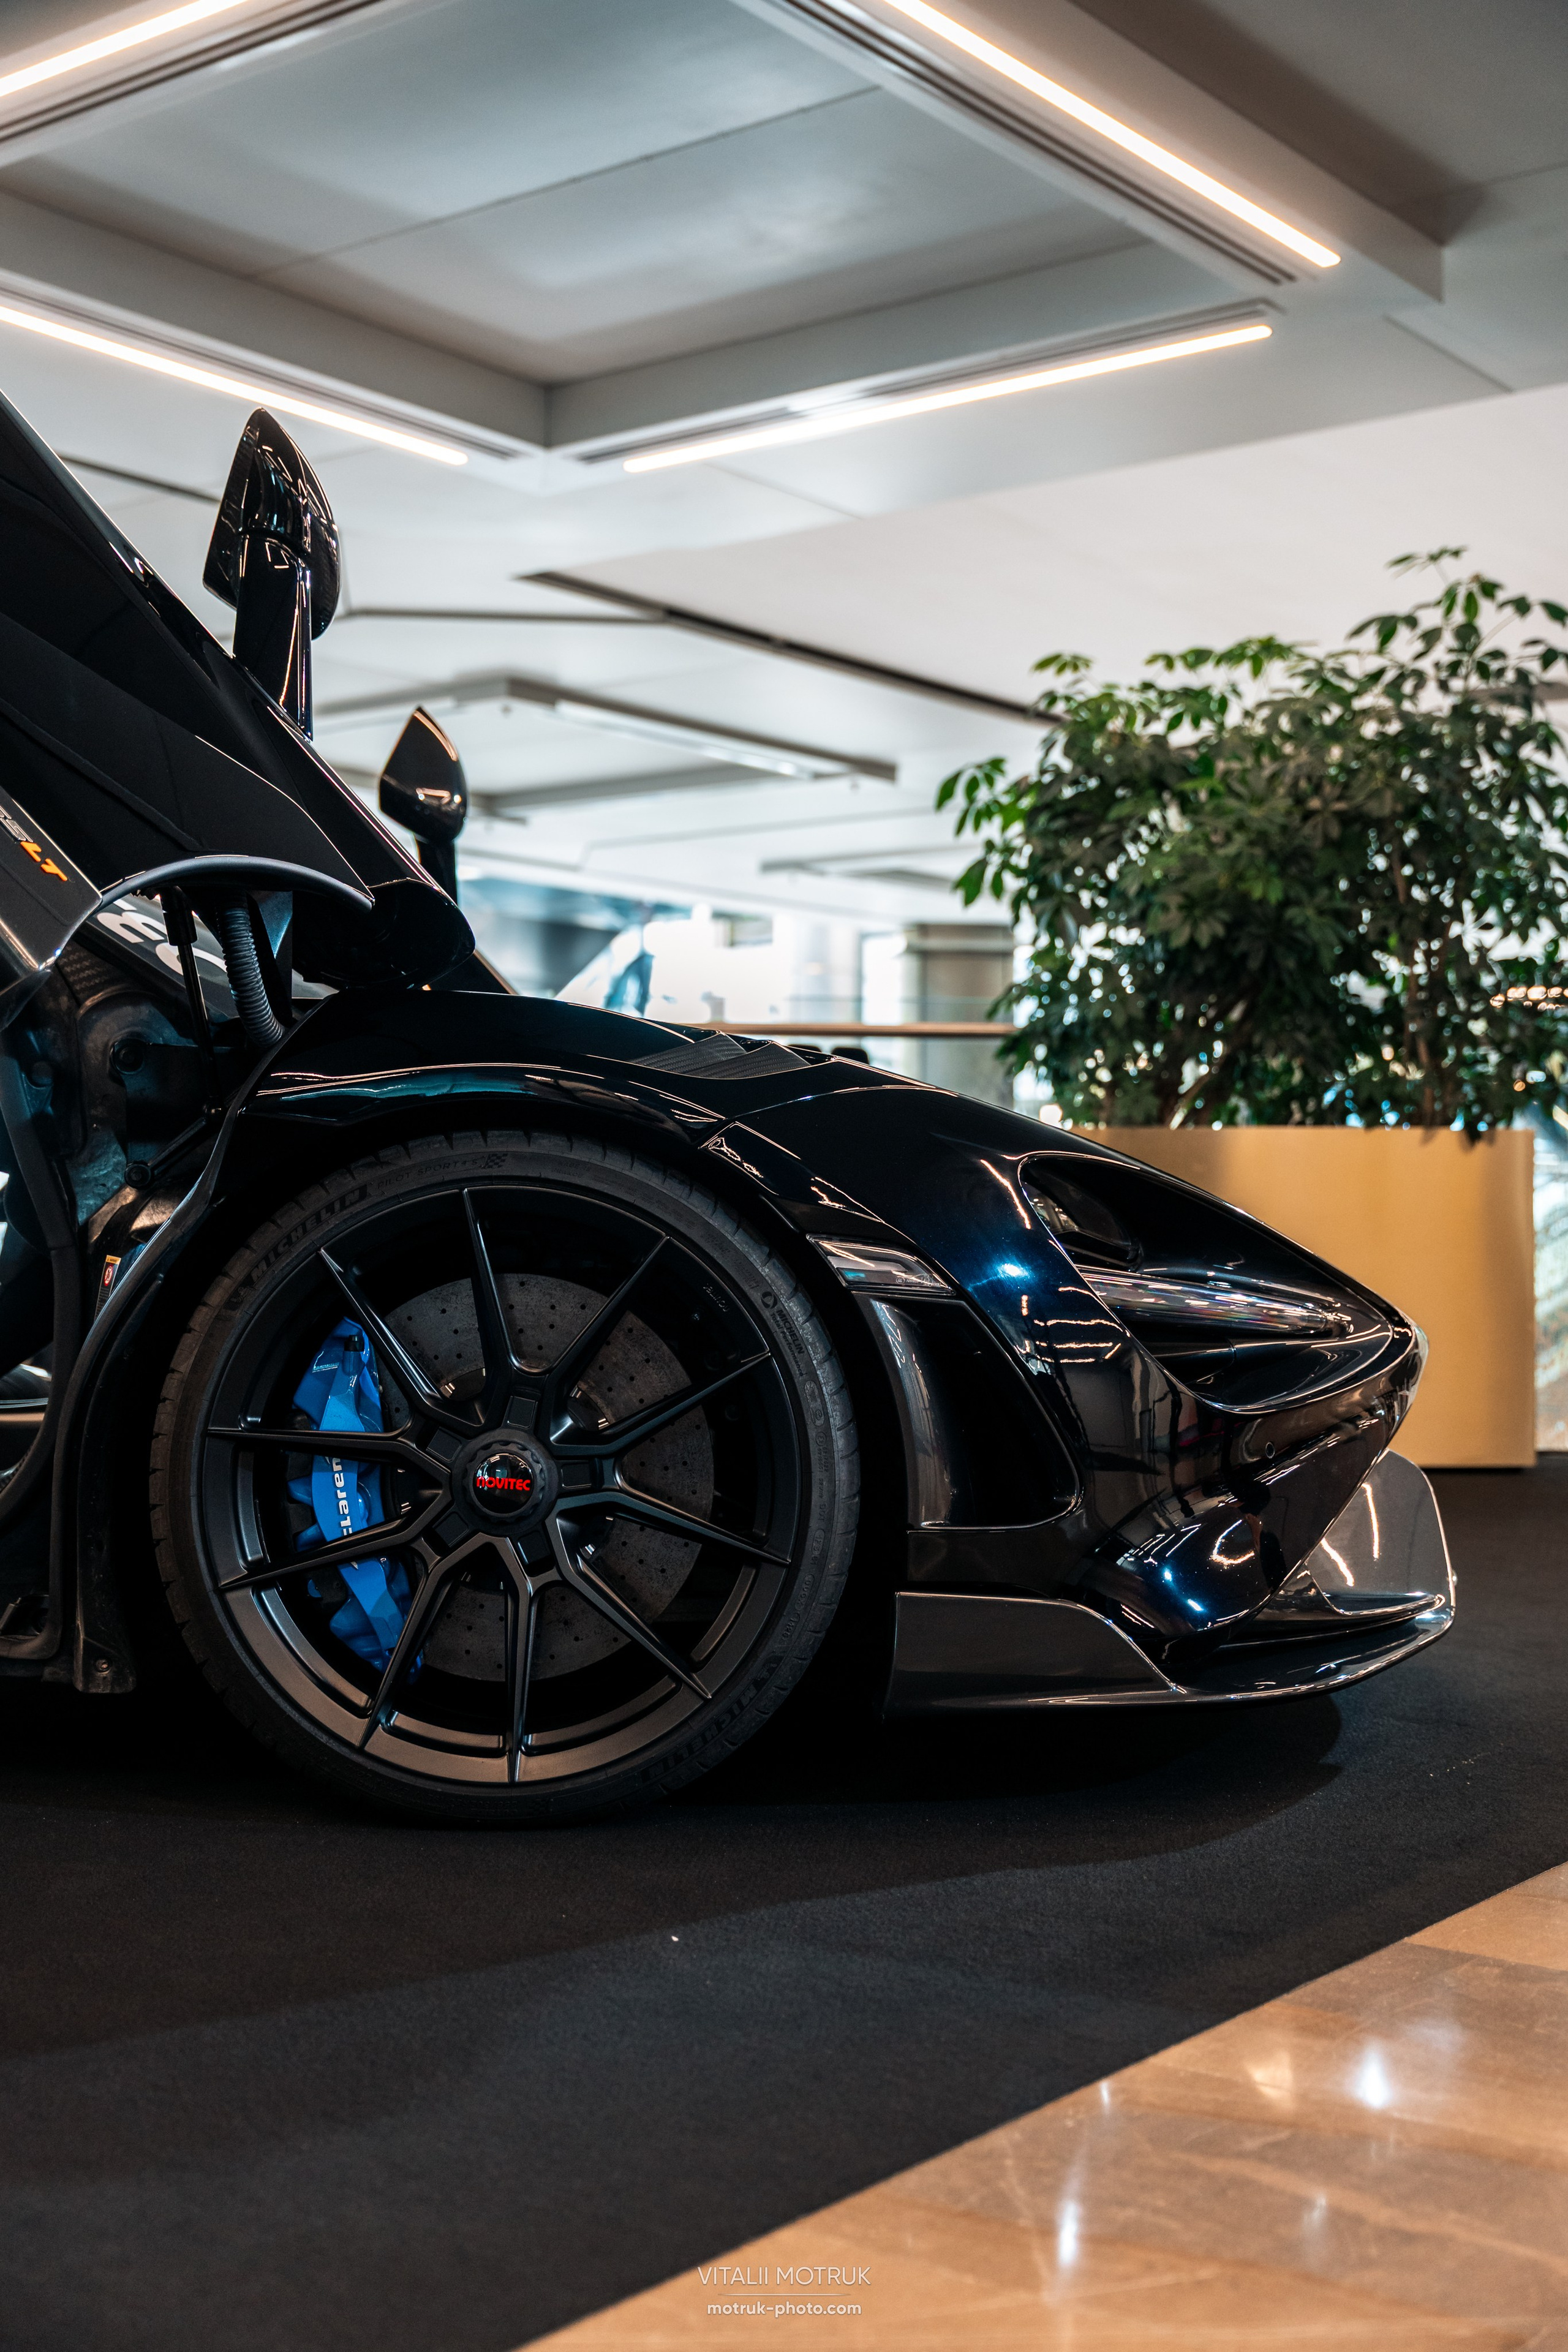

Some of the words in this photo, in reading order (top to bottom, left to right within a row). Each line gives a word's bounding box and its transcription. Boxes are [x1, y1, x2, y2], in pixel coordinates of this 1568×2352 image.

[377, 1172, 411, 1189] PILOT
[417, 1161, 459, 1175] SPORT
[250, 1189, 360, 1283] MICHELIN
[771, 1313, 783, 1332] Total
[782, 1330, 805, 1377] Performance
[776, 1309, 805, 1354] MICHELIN
[477, 1476, 531, 1491] NOVITEC
[648, 1686, 758, 1777] MICHELIN
